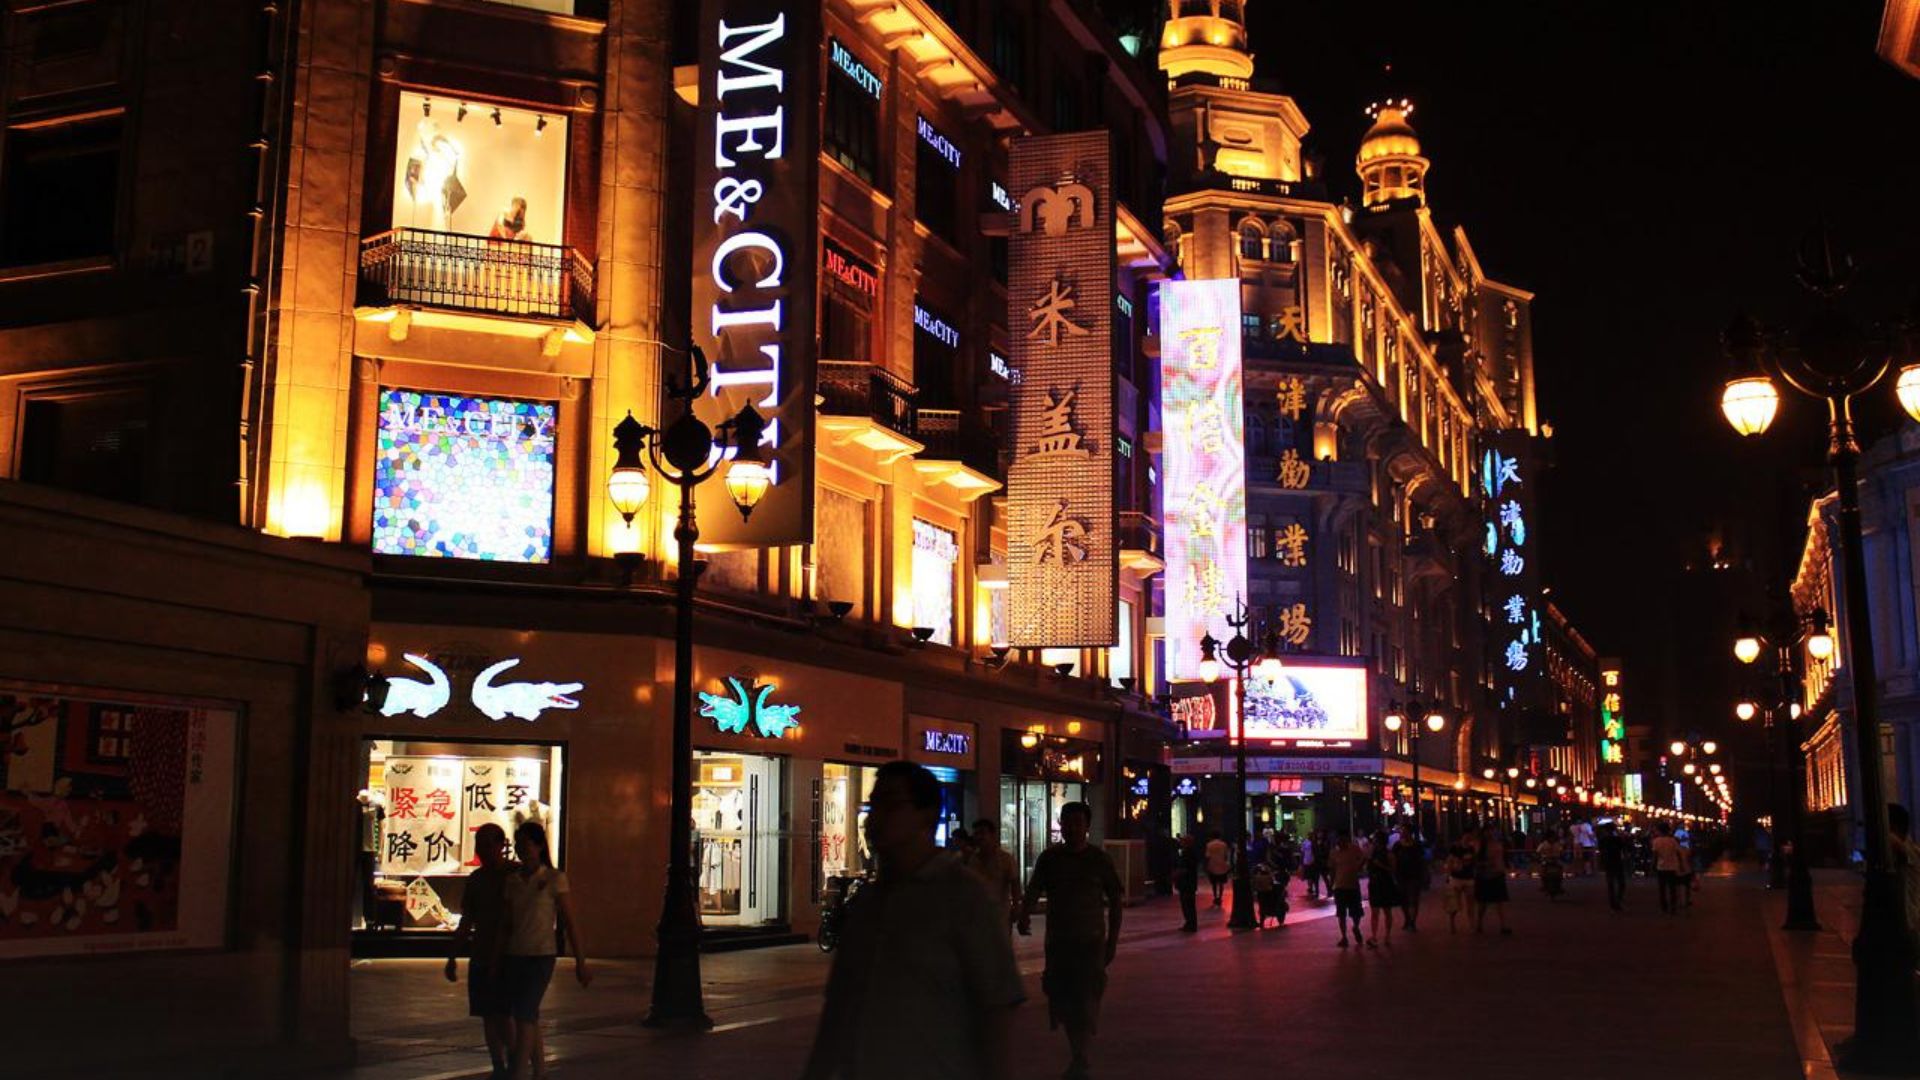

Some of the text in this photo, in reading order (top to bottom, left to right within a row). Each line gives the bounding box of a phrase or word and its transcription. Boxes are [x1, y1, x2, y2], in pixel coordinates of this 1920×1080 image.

[832, 41, 882, 100] ME&CITY
[917, 115, 961, 168] ME&CITY
[826, 248, 879, 297] ME&CITY
[914, 304, 959, 348] ME&CITY
[386, 402, 552, 440] ME&CITY
[925, 730, 970, 755] ME&CITY
[388, 786, 456, 820] 紧急
[466, 782, 532, 813] 低至
[387, 830, 454, 864] 降价
